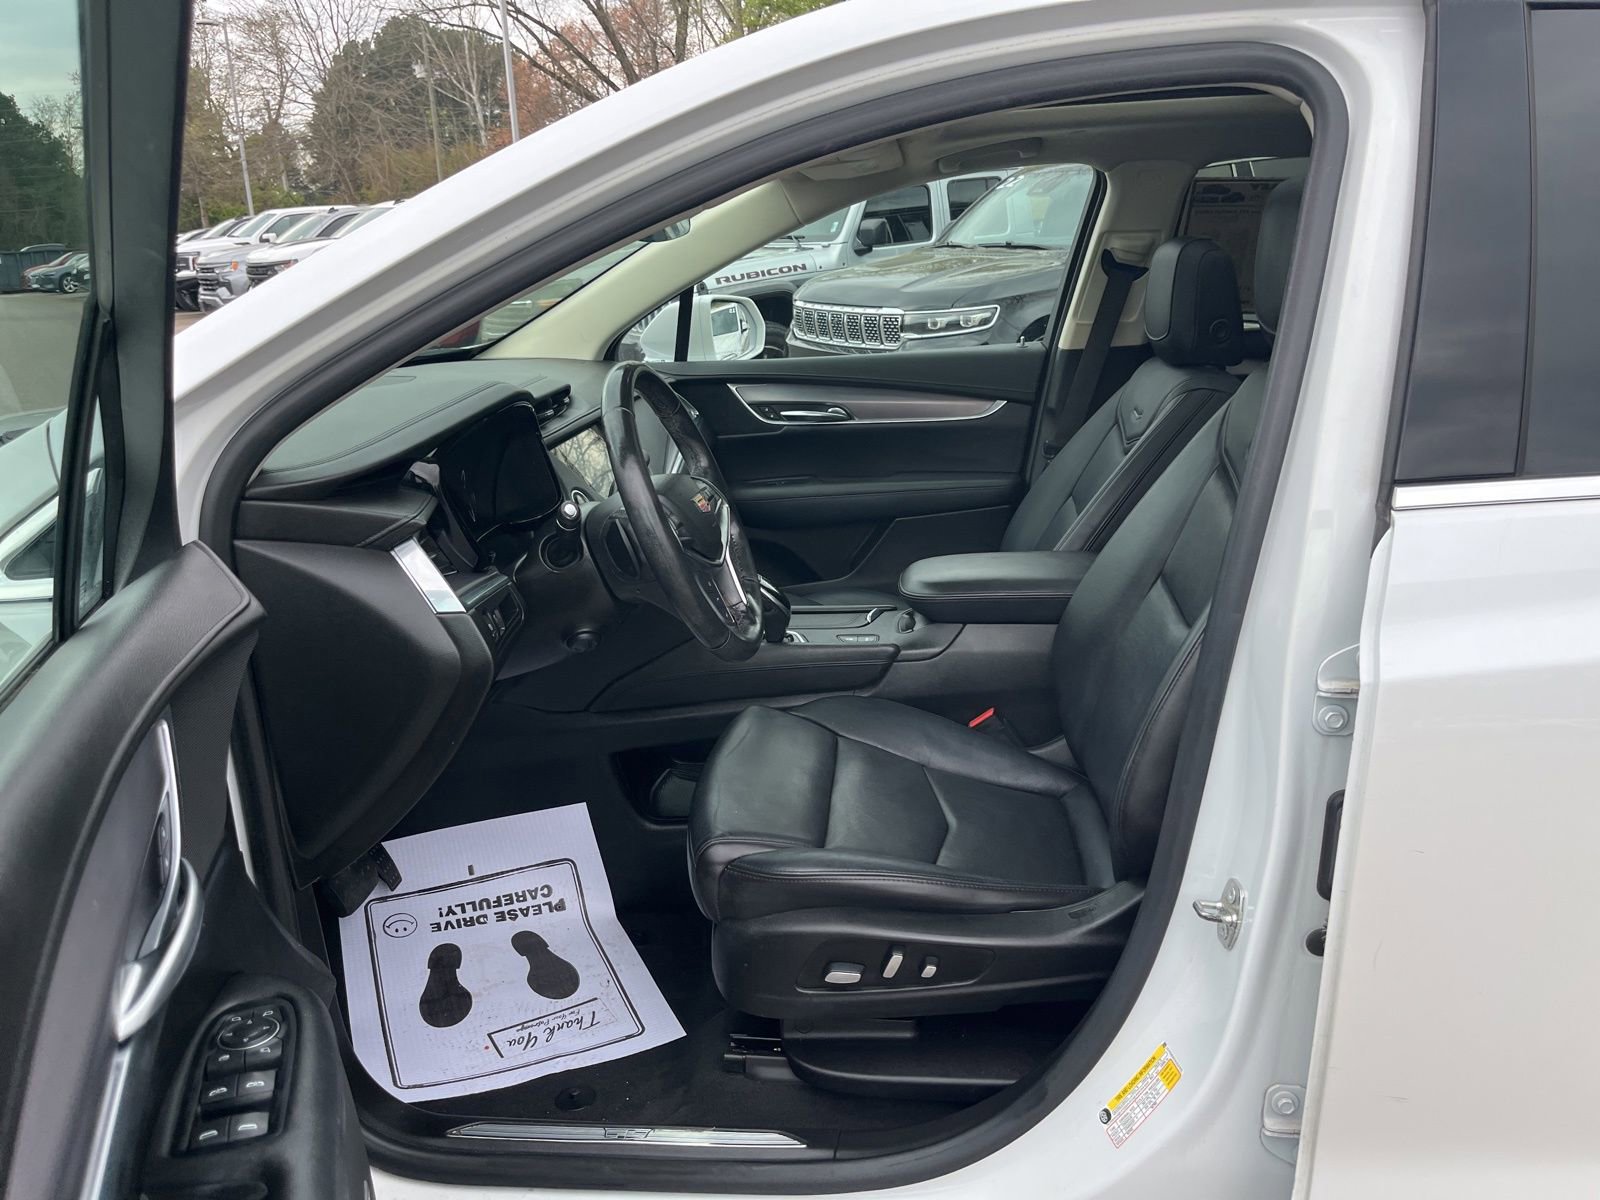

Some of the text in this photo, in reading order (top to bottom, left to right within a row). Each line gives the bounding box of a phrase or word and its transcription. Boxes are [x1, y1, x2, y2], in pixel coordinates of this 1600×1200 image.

[715, 263, 807, 285] RUBICON
[430, 898, 567, 933] PLEASE DRIVE
[438, 884, 553, 918] CAREFULLY!
[506, 1011, 600, 1051] Thank You
